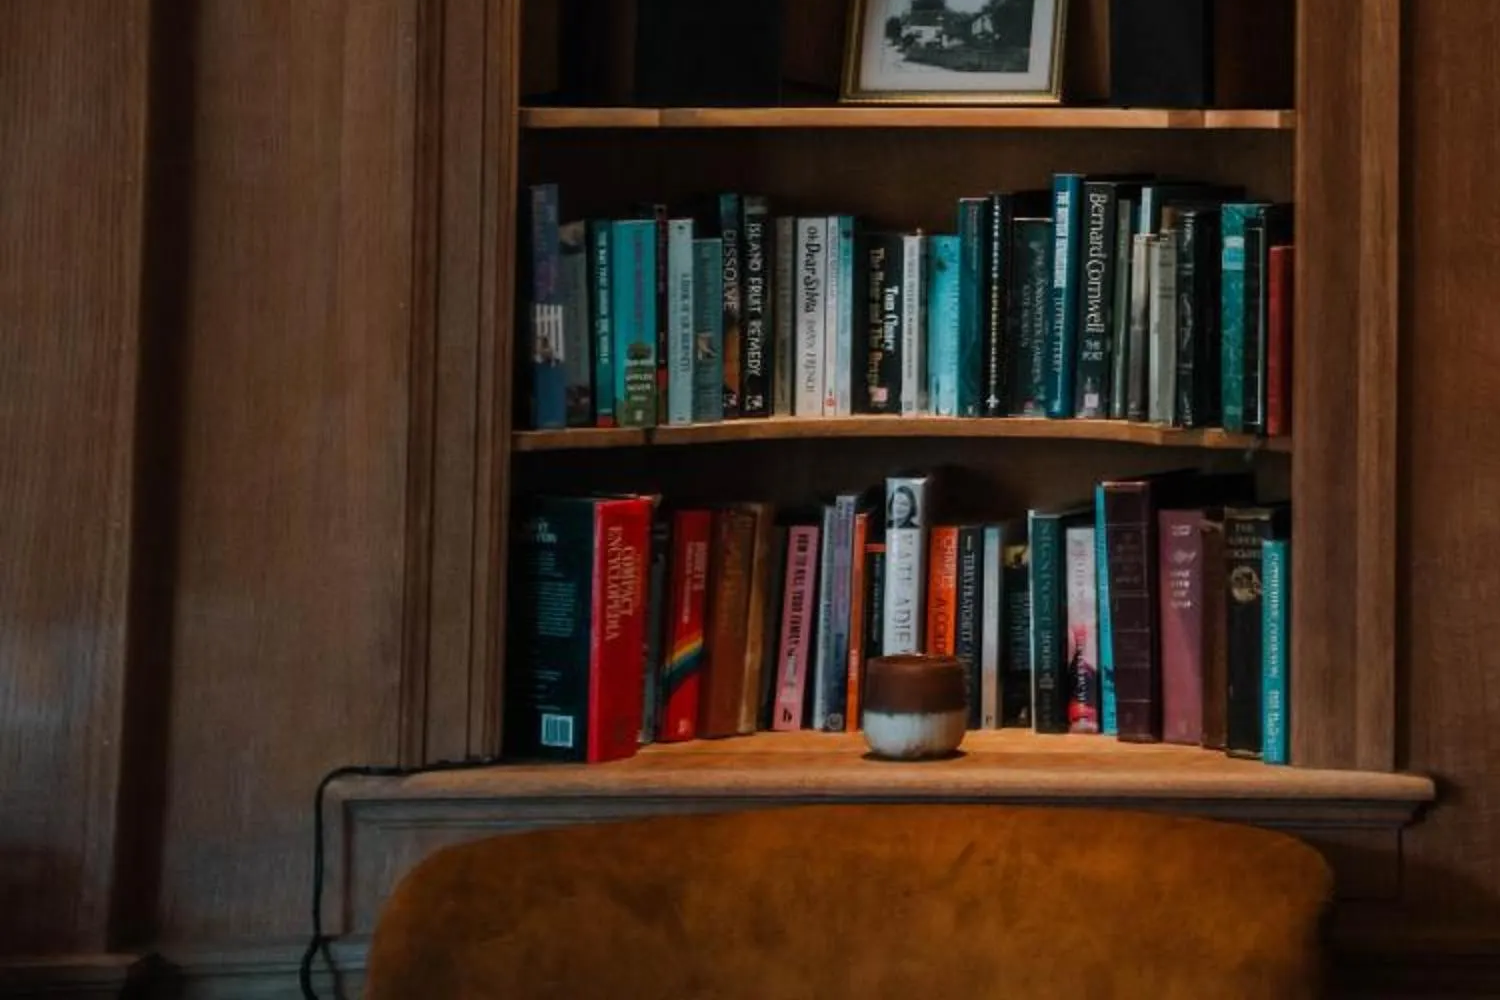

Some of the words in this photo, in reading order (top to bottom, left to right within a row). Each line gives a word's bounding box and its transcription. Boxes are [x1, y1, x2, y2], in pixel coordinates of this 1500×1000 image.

[1088, 192, 1108, 258] Bernard
[746, 223, 763, 271] ISLAND
[805, 242, 821, 275] Dear
[723, 229, 738, 312] DISSOLVE
[747, 276, 763, 314] FRUIT
[884, 286, 899, 311] Tom
[1084, 258, 1107, 333] Cornwell
[745, 319, 762, 376] REMEDY
[883, 315, 899, 353] Clancy
[1085, 340, 1101, 350] THE
[794, 569, 807, 586] KILL
[900, 532, 913, 581] KATE
[963, 552, 975, 583] TERRY
[620, 545, 636, 617] COMPACT
[791, 589, 805, 613] YOUR
[788, 614, 803, 645] FAMILY
[895, 597, 913, 644] ADIE
[961, 584, 974, 642] PRATCHETT
